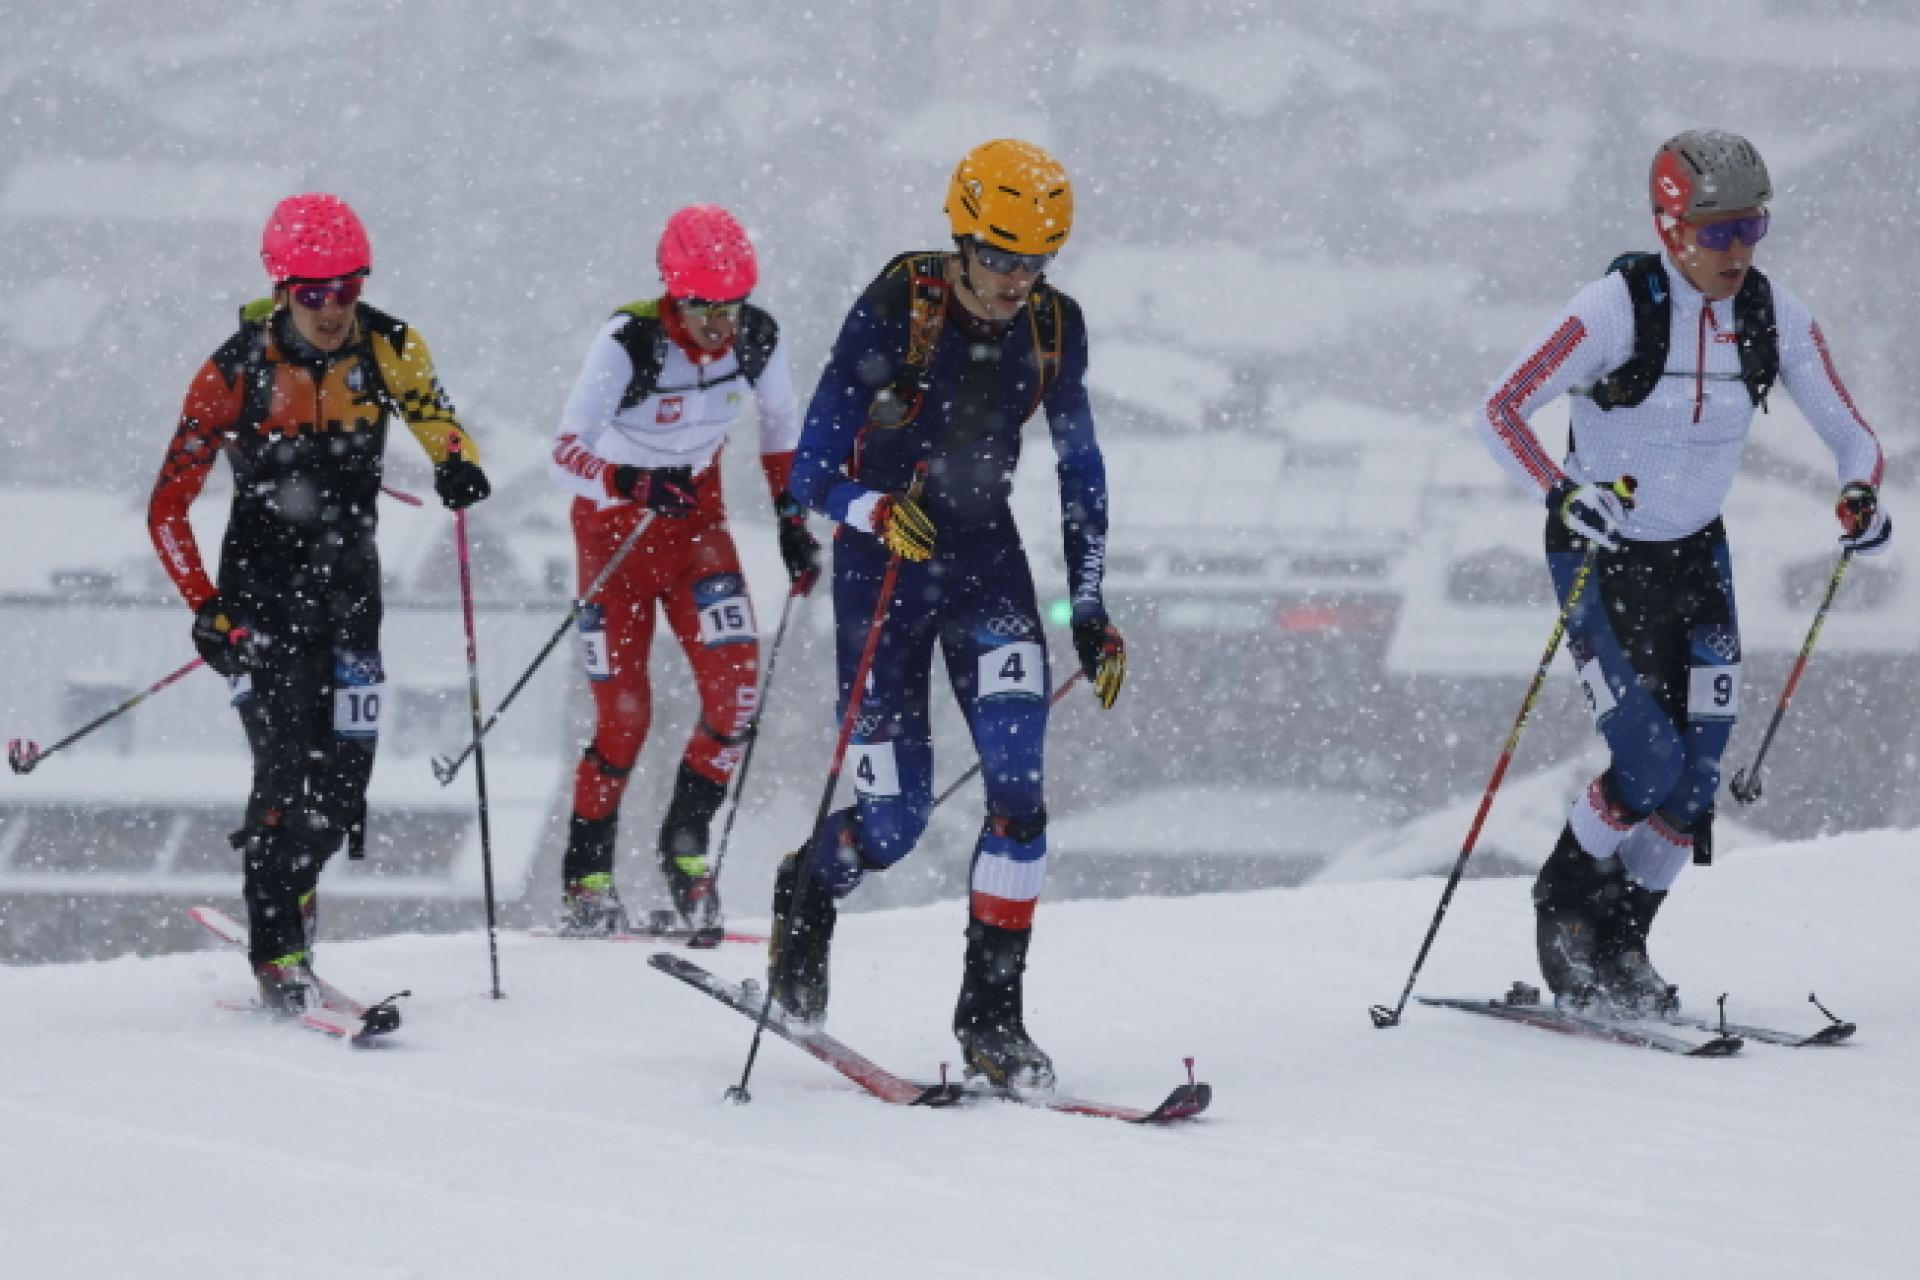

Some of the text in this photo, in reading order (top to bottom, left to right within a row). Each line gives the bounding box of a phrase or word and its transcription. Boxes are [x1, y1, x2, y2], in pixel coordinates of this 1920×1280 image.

[709, 605, 744, 632] 15
[999, 652, 1026, 682] 4
[1713, 673, 1733, 707] 9
[348, 694, 379, 722] 10
[856, 754, 876, 786] 4
